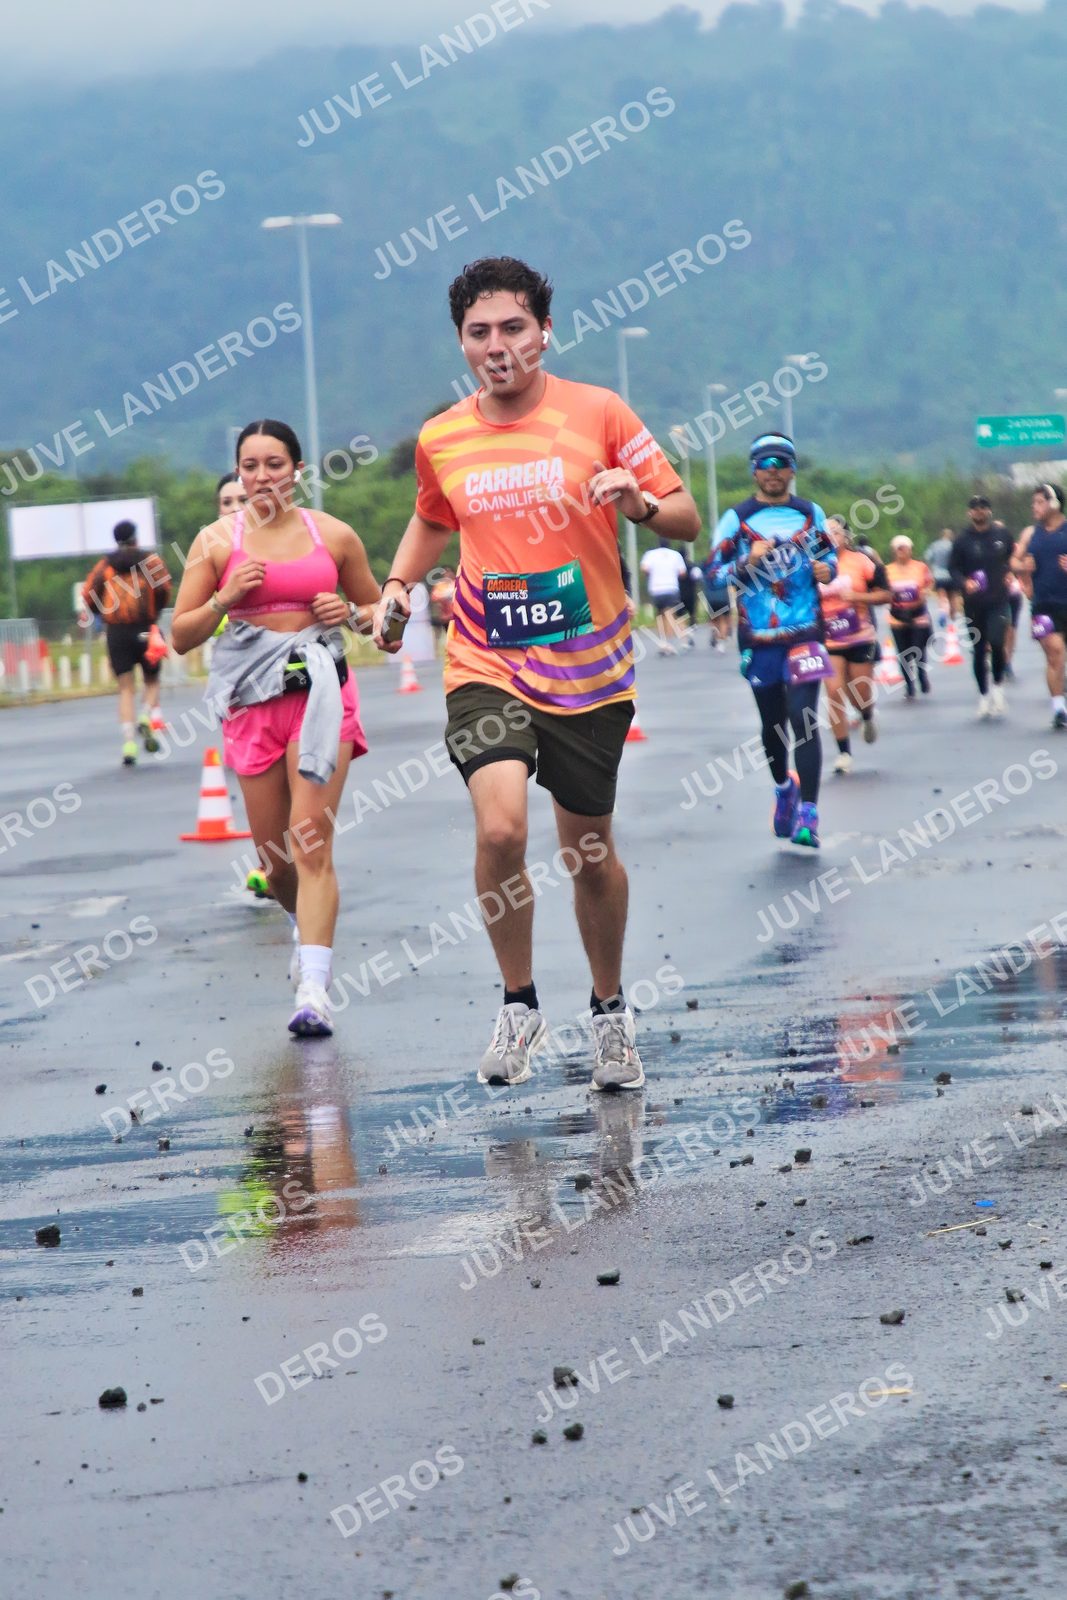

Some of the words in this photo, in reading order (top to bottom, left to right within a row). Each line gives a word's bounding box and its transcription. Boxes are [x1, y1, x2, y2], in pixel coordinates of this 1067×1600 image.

[465, 456, 564, 496] CARRERA
[468, 487, 544, 515] OMNILIFE
[487, 579, 527, 591] CARRERA
[557, 568, 575, 588] 10K
[487, 592, 519, 600] OMNILIFE
[500, 600, 564, 627] 1182
